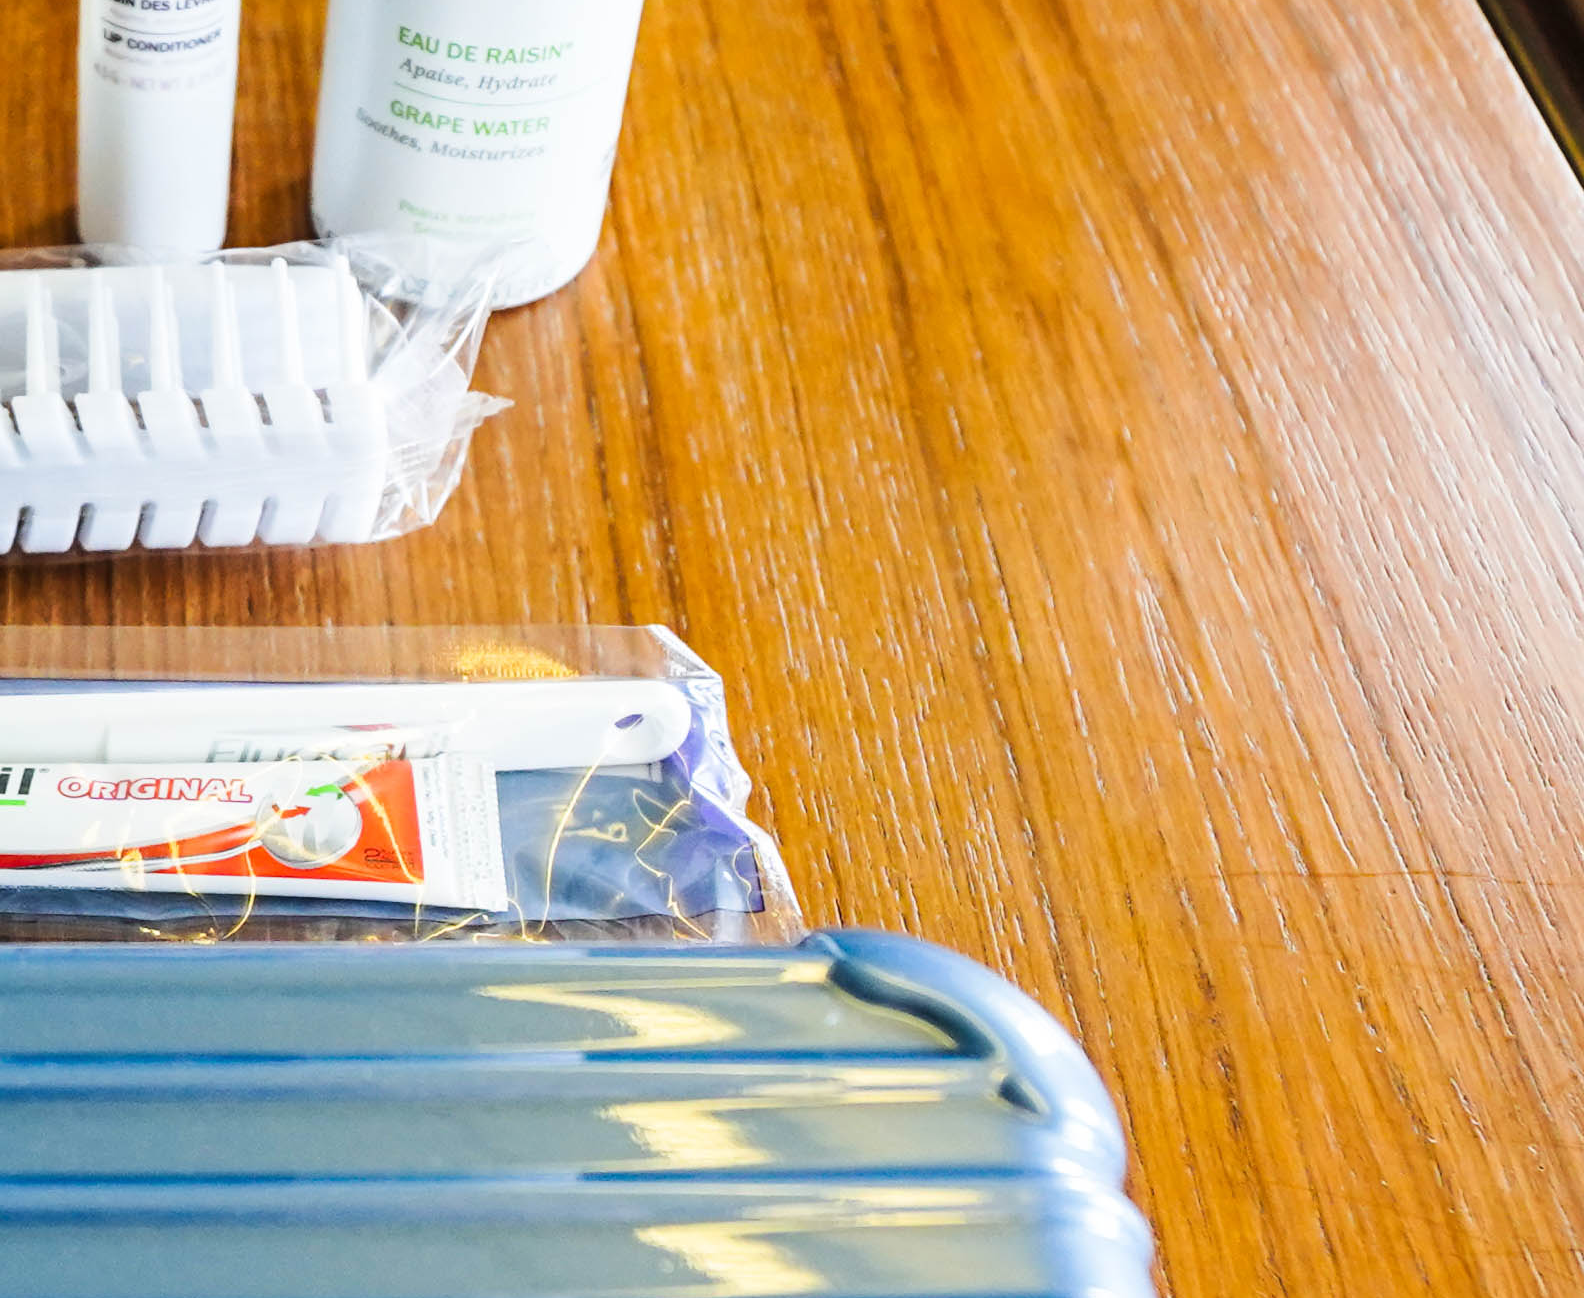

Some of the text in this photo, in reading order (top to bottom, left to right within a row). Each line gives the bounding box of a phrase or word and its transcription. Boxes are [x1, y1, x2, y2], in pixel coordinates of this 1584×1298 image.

[397, 25, 441, 55] EAU
[446, 41, 479, 63] DE
[389, 99, 552, 137] GRAPE WATER
[56, 775, 253, 804] ORIGINAL
